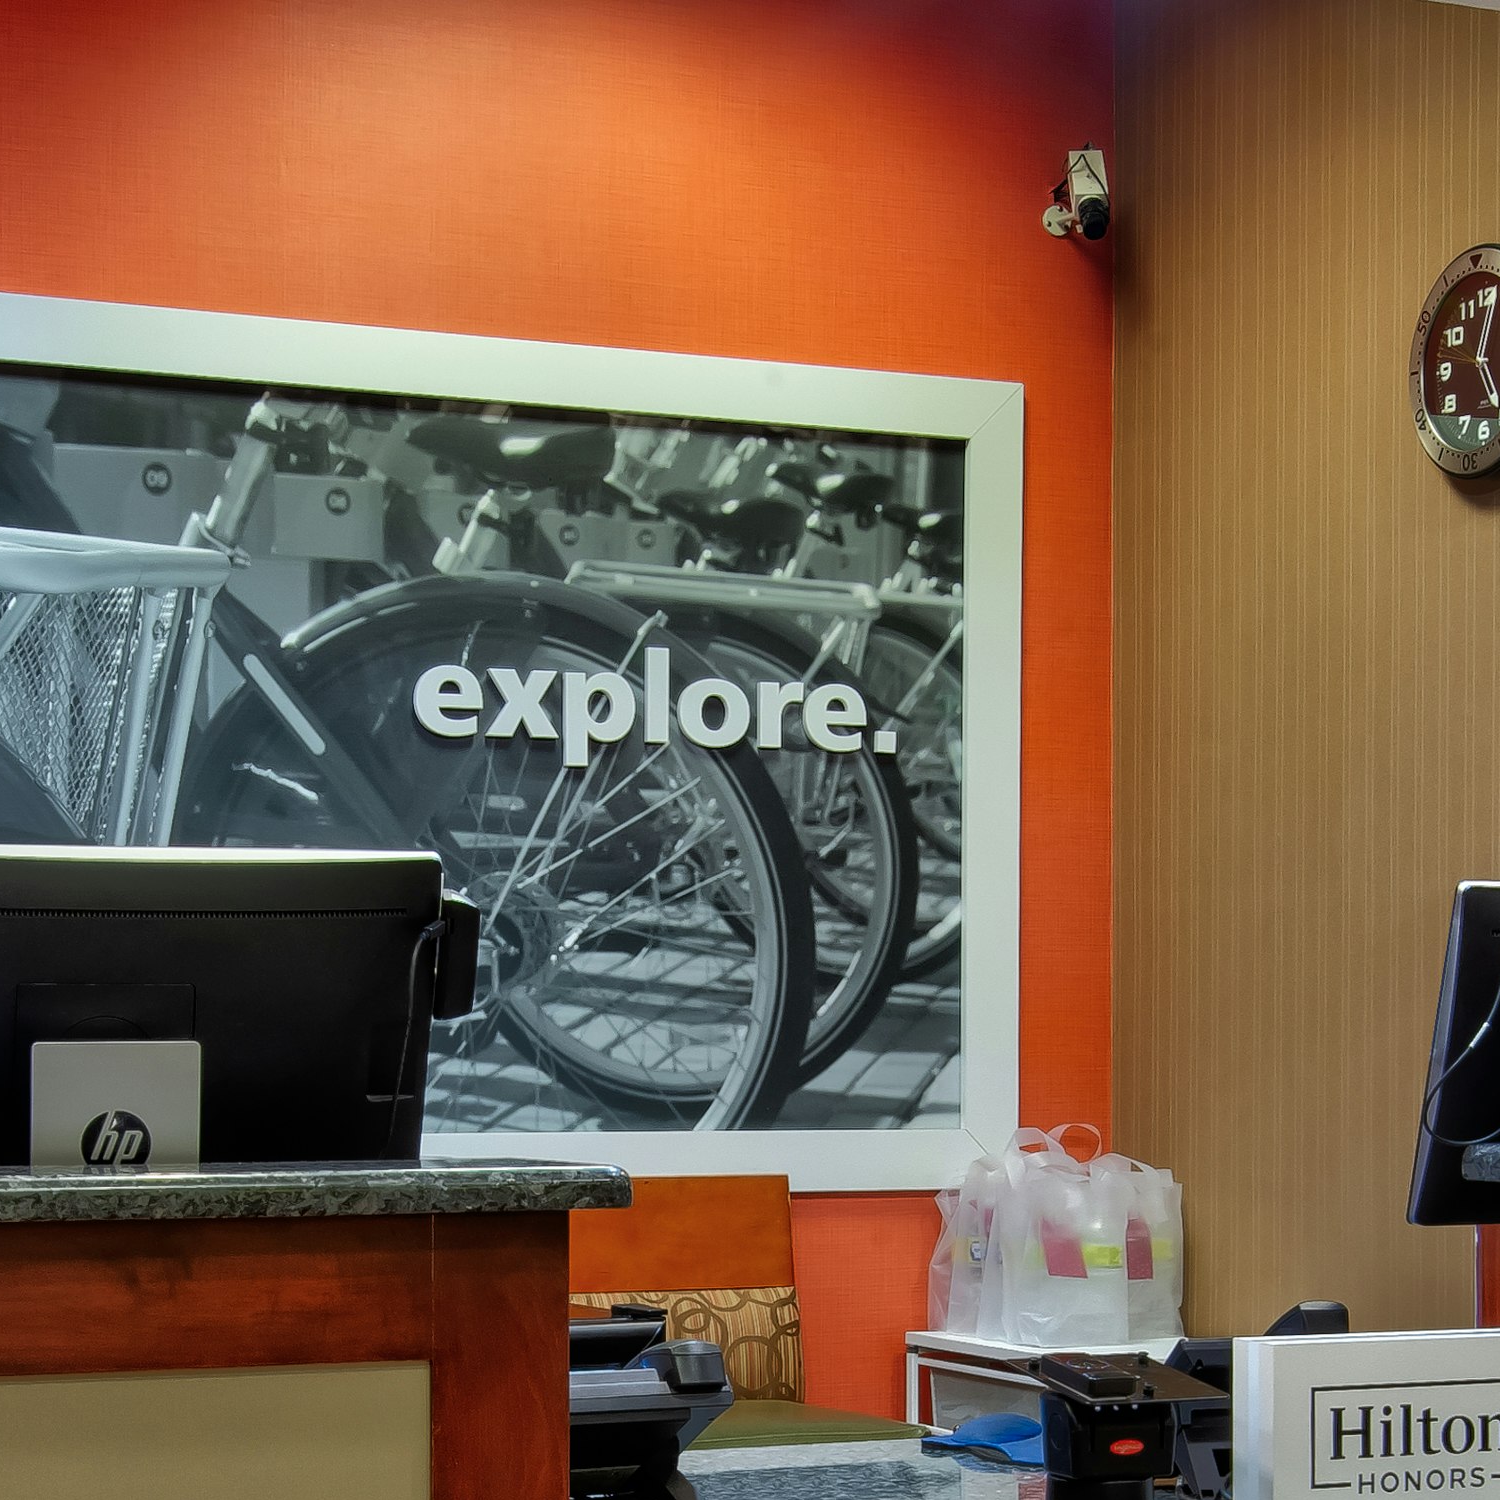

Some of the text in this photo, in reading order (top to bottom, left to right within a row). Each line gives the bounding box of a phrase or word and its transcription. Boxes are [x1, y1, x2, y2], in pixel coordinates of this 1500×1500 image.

[1459, 299, 1475, 320] 11
[1418, 311, 1431, 335] 50
[1444, 326, 1464, 347] 10
[1440, 362, 1451, 381] 9
[1443, 394, 1457, 413] 8
[1458, 414, 1471, 435] 7
[1477, 420, 1489, 440] 6
[412, 646, 897, 768] explore.
[90, 1111, 144, 1165] hp
[1357, 1466, 1486, 1495] HONORS
